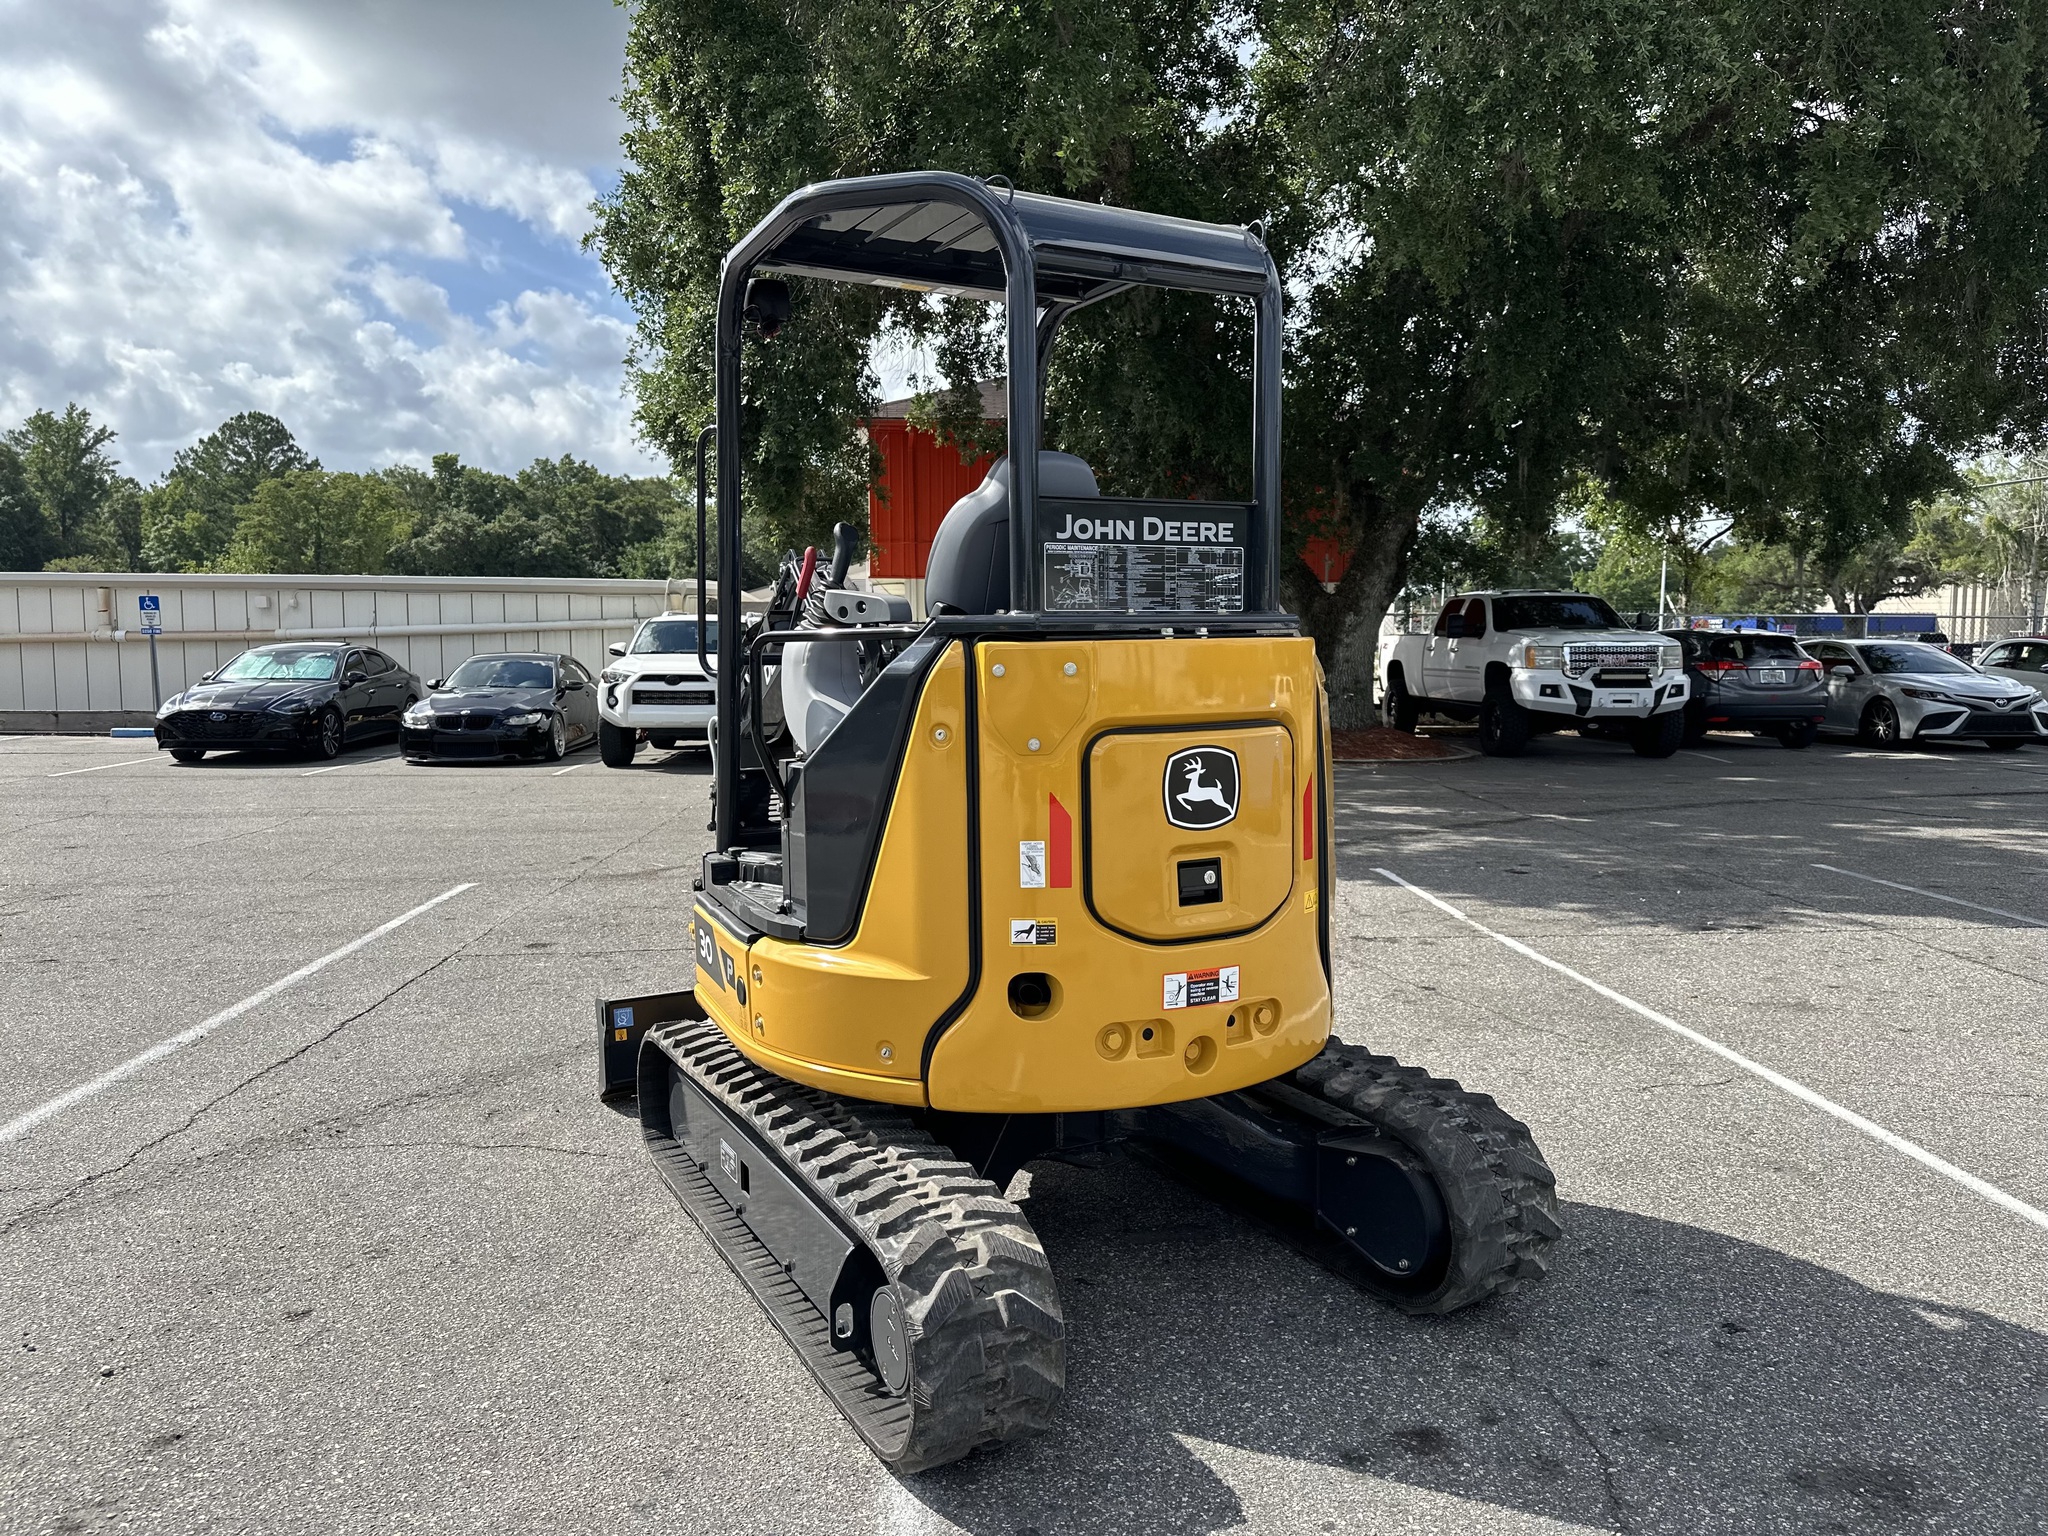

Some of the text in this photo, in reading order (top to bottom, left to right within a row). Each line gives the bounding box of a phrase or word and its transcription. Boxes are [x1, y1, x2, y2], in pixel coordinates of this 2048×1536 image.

[1056, 514, 1234, 542] JOHN DEERE
[1598, 655, 1636, 666] GMC
[699, 928, 713, 965] 30
[726, 957, 733, 980] P
[1193, 971, 1219, 979] WARNING
